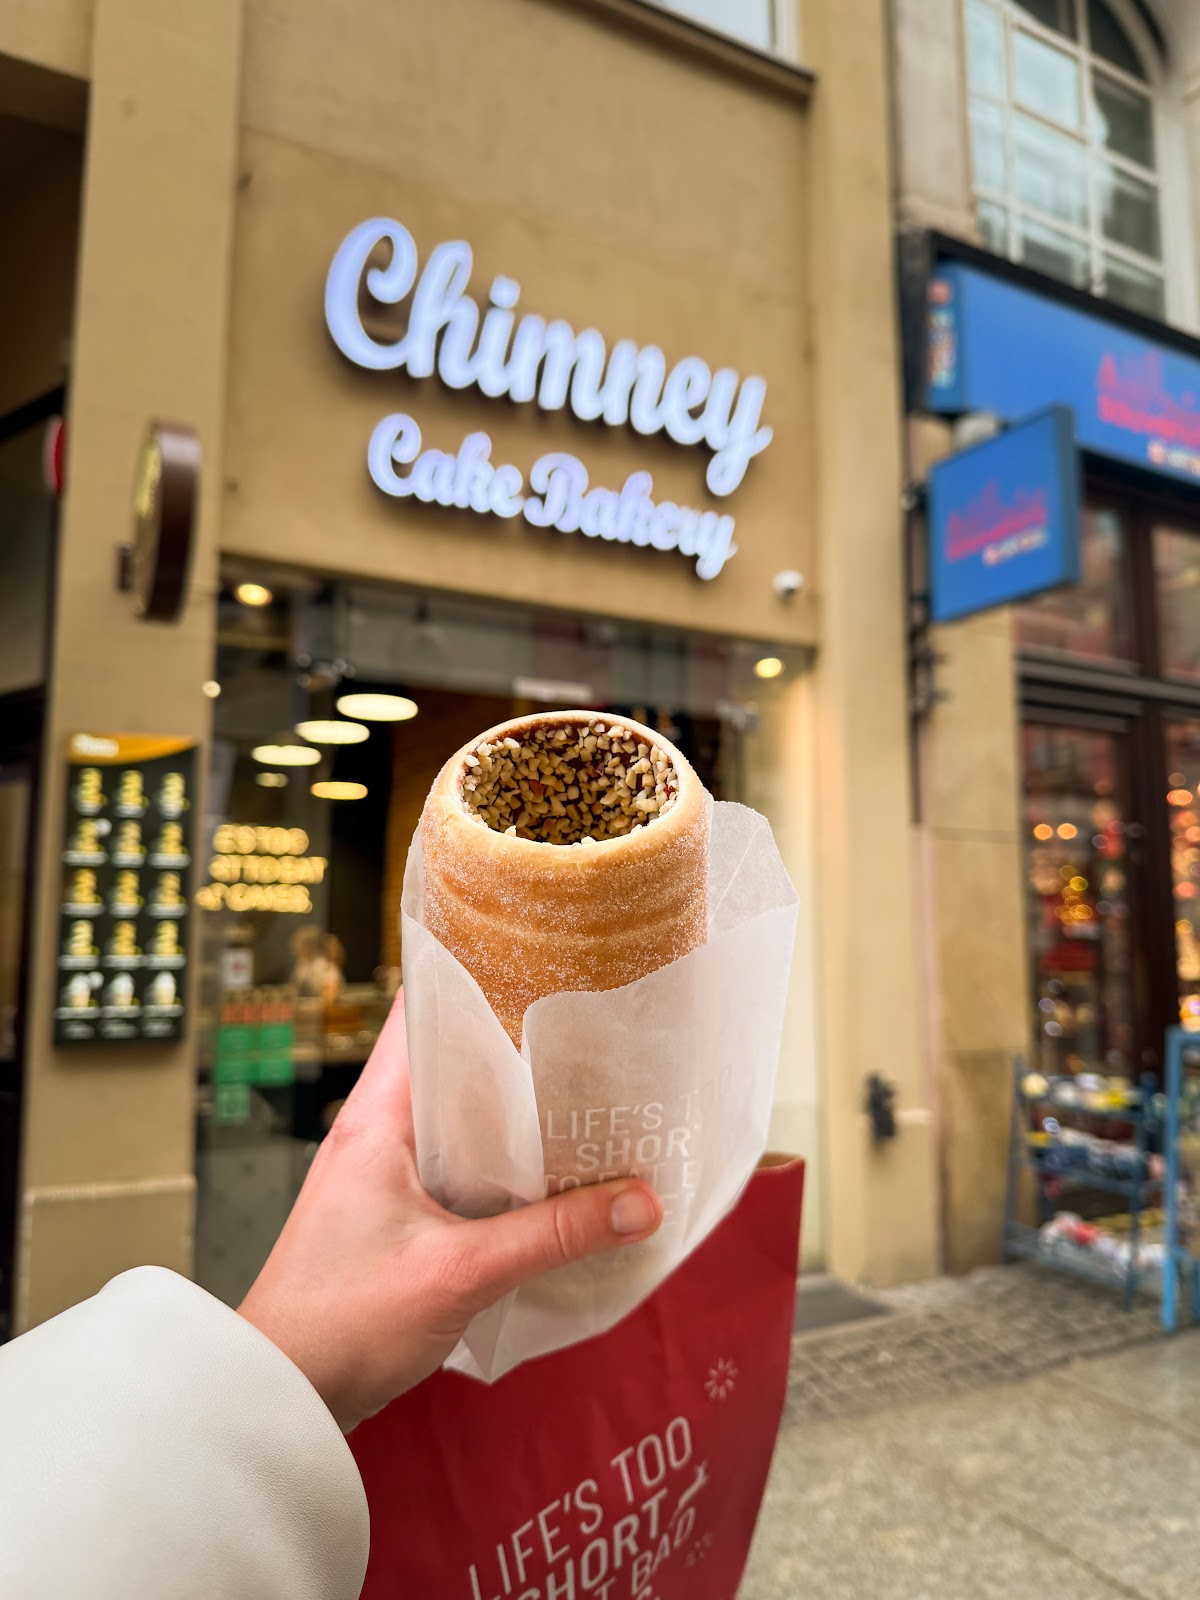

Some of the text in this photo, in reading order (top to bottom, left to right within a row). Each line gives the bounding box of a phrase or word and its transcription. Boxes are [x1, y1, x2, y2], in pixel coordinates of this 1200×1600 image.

[324, 216, 774, 497] Chimney
[367, 413, 739, 581] Cake Bakery
[546, 1101, 664, 1140] LIFE'S
[469, 1416, 693, 1600] LIFE'S TOO
[514, 1487, 669, 1600] HORT
[631, 1506, 696, 1597] BAD
